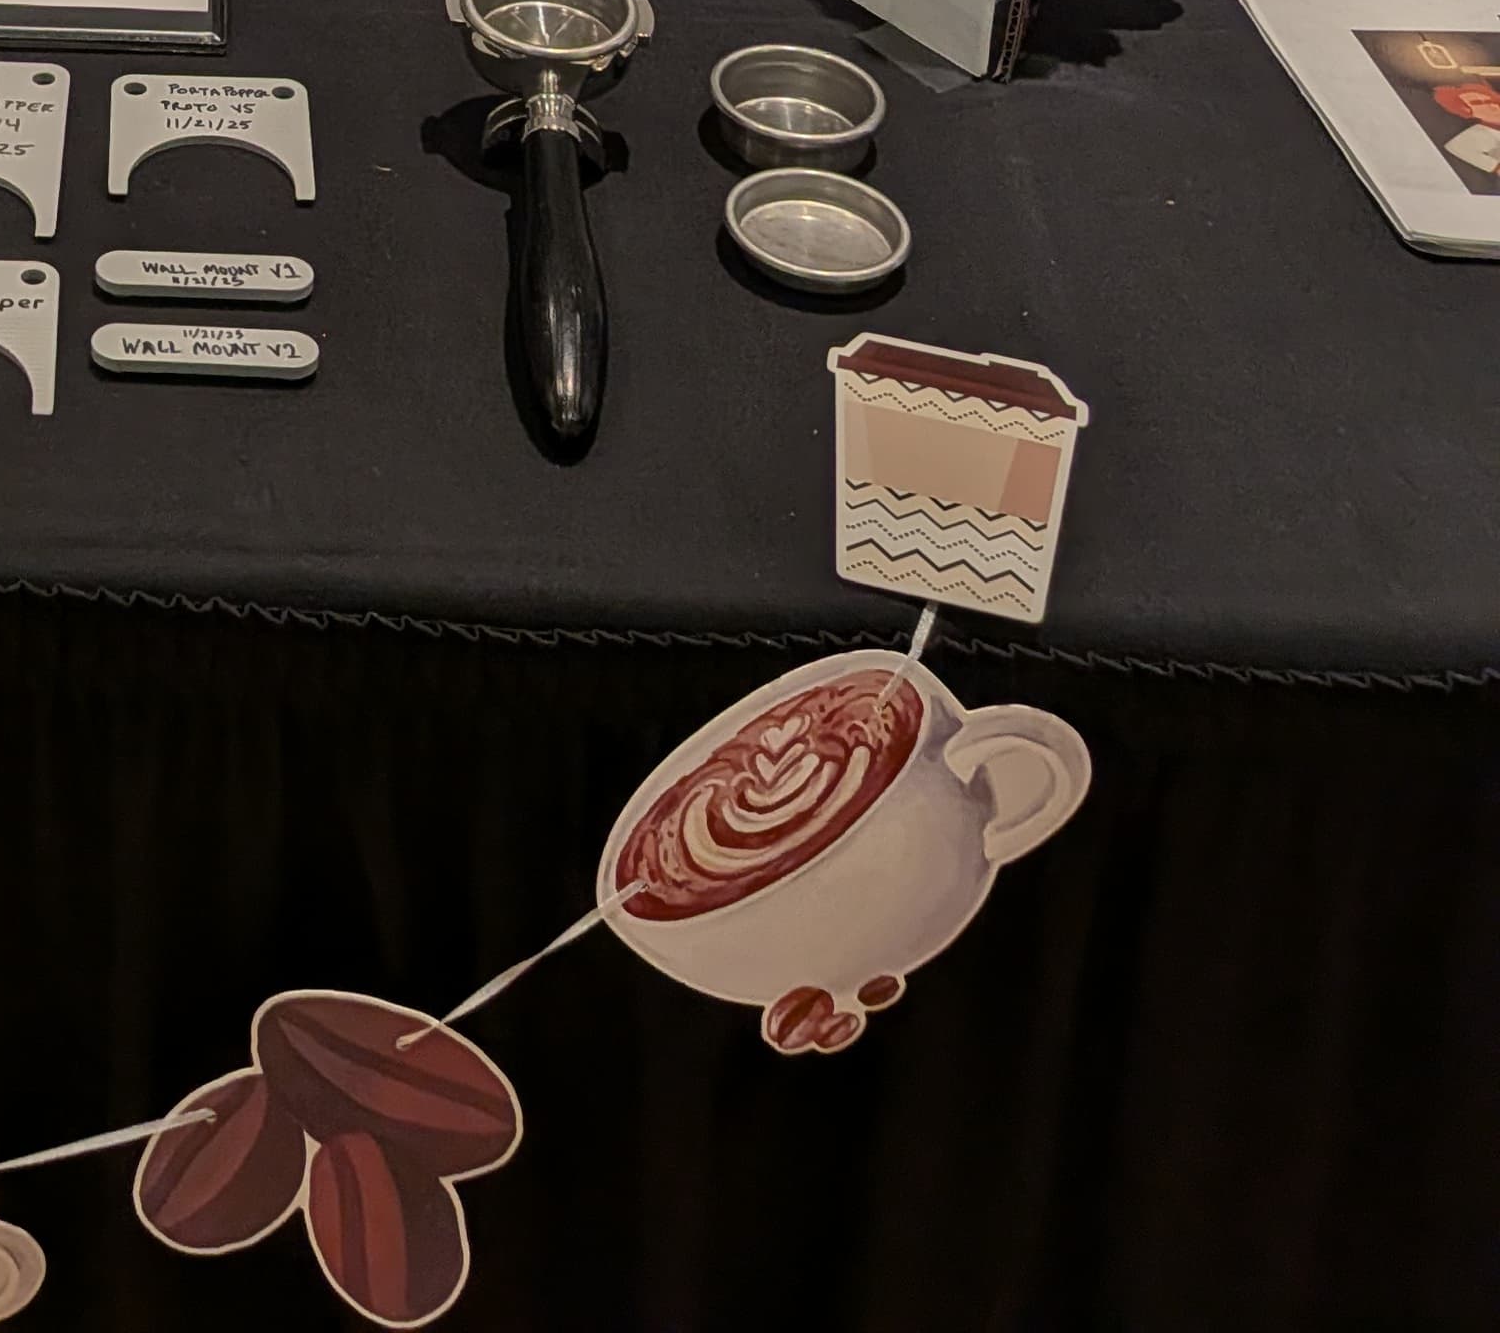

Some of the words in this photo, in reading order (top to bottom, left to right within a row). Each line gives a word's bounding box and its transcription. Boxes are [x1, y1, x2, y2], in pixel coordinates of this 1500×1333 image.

[166, 117, 253, 130] 11/21/25
[142, 261, 197, 275] WALL
[203, 264, 259, 277] MOUNT
[122, 337, 181, 355] WALL
[193, 342, 261, 357] MOUNT
